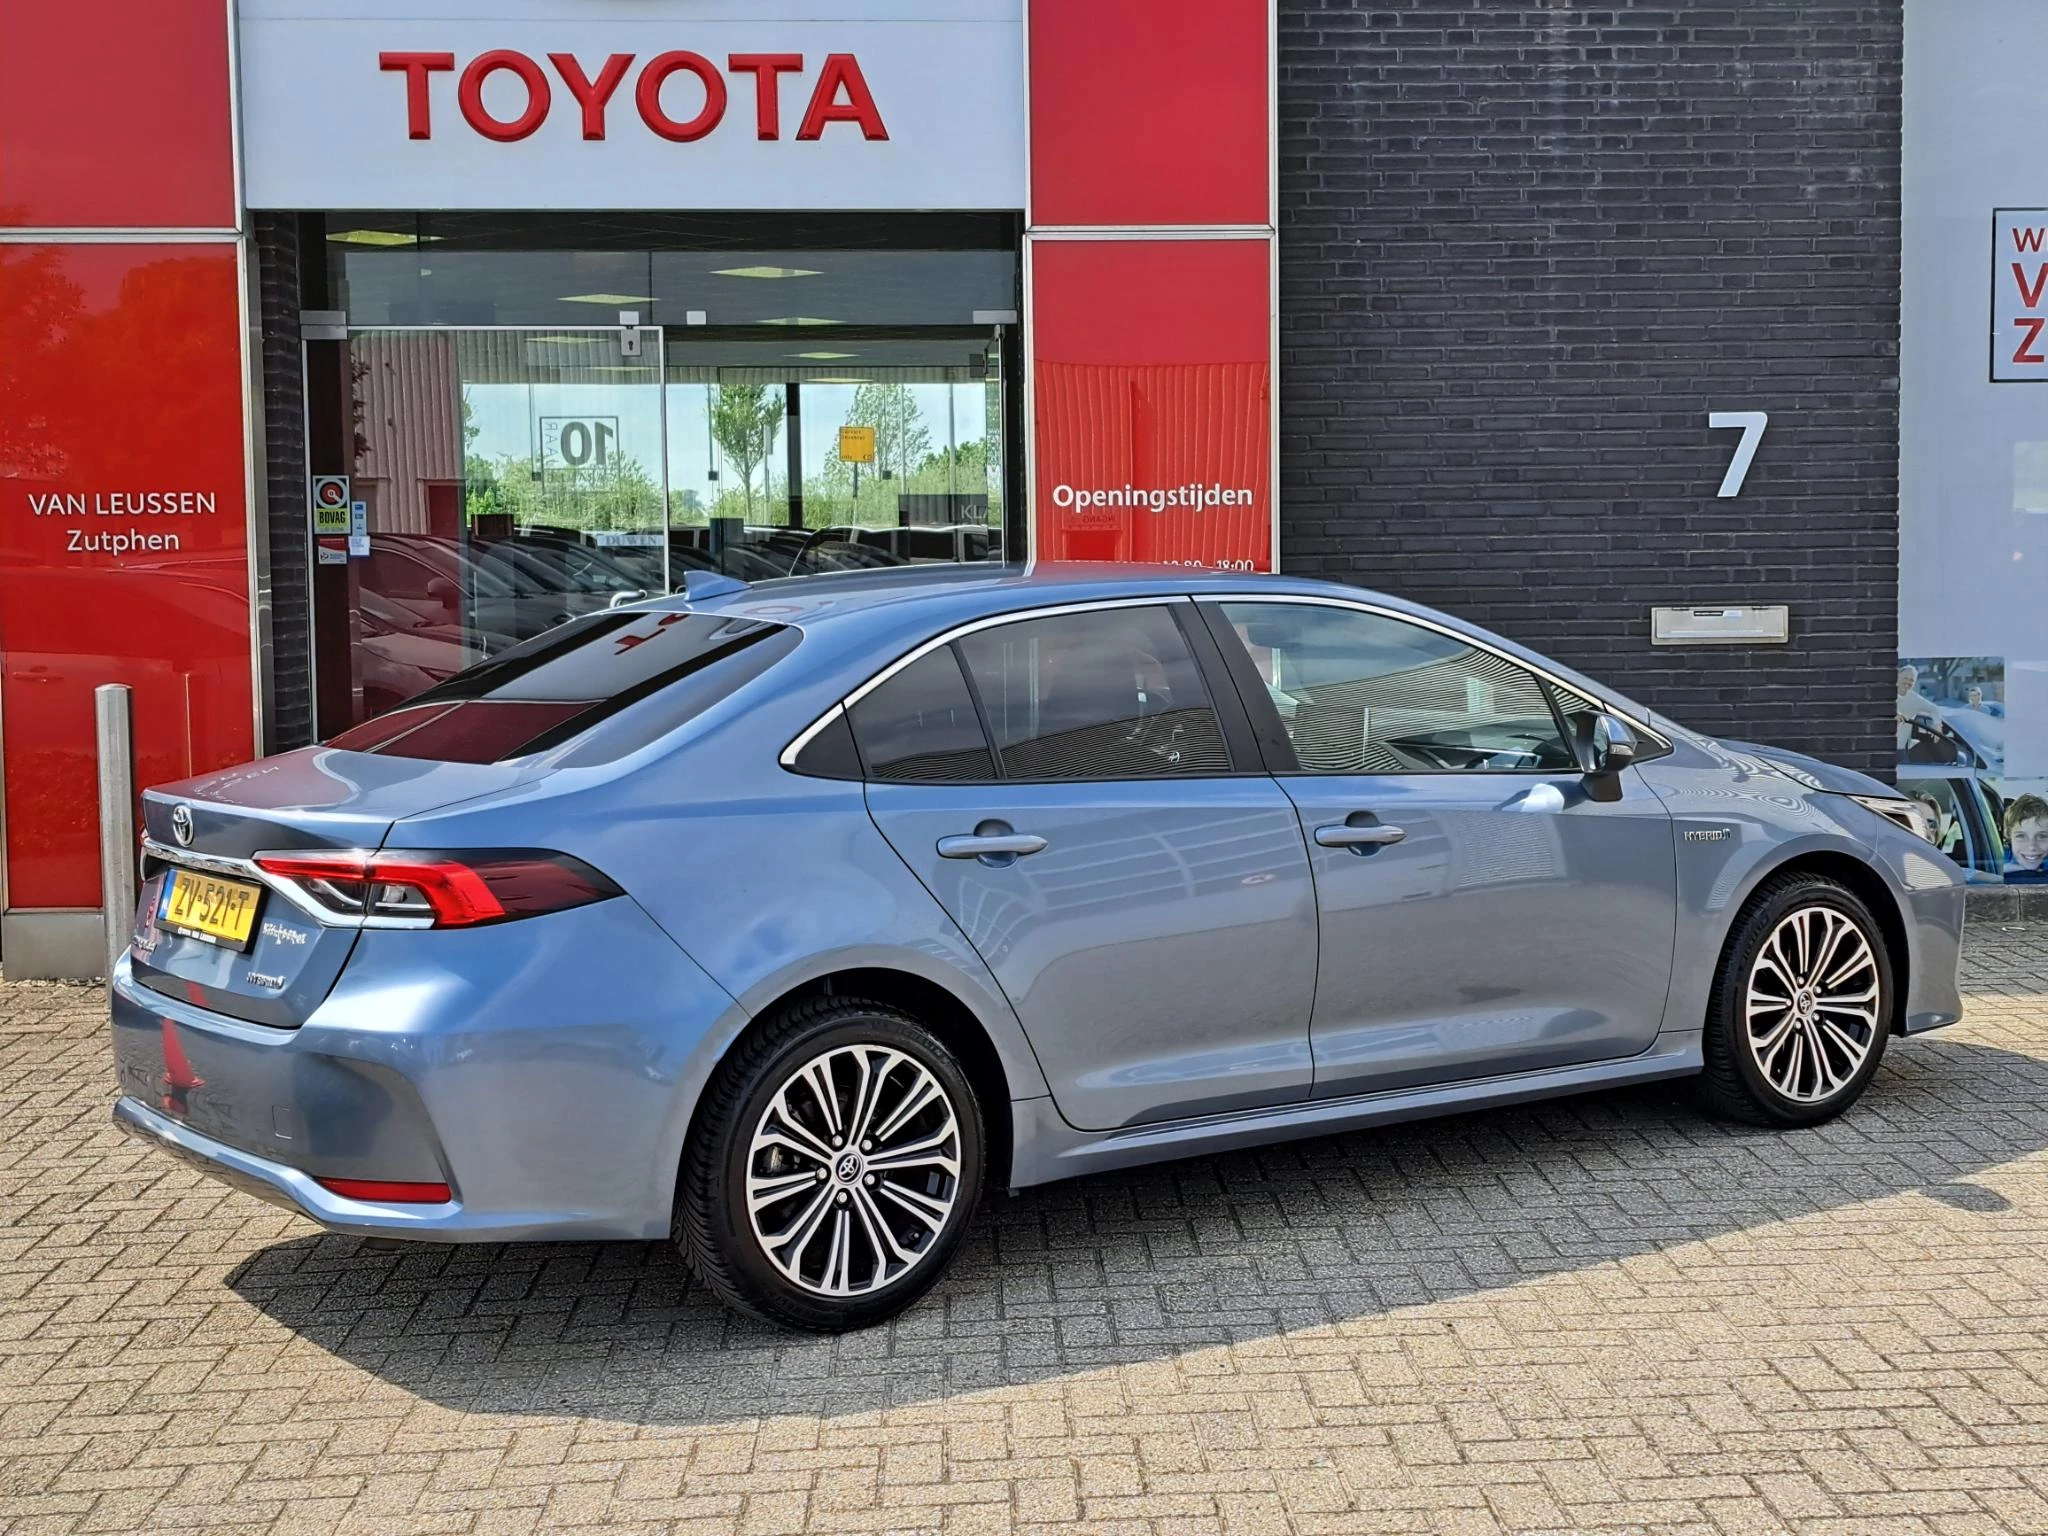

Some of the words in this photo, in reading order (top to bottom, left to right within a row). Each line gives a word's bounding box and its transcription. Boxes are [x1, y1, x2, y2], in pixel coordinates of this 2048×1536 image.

[379, 50, 889, 142] TOYOTA
[1709, 412, 1768, 497] 7
[28, 493, 85, 514] VAN
[96, 492, 215, 514] LEUSSEN
[1053, 484, 1253, 512] Openingstijden
[319, 511, 346, 524] BOVAG
[67, 529, 179, 556] Zutphen
[606, 534, 656, 545] DUWEN
[1684, 831, 1722, 840] HYBRID
